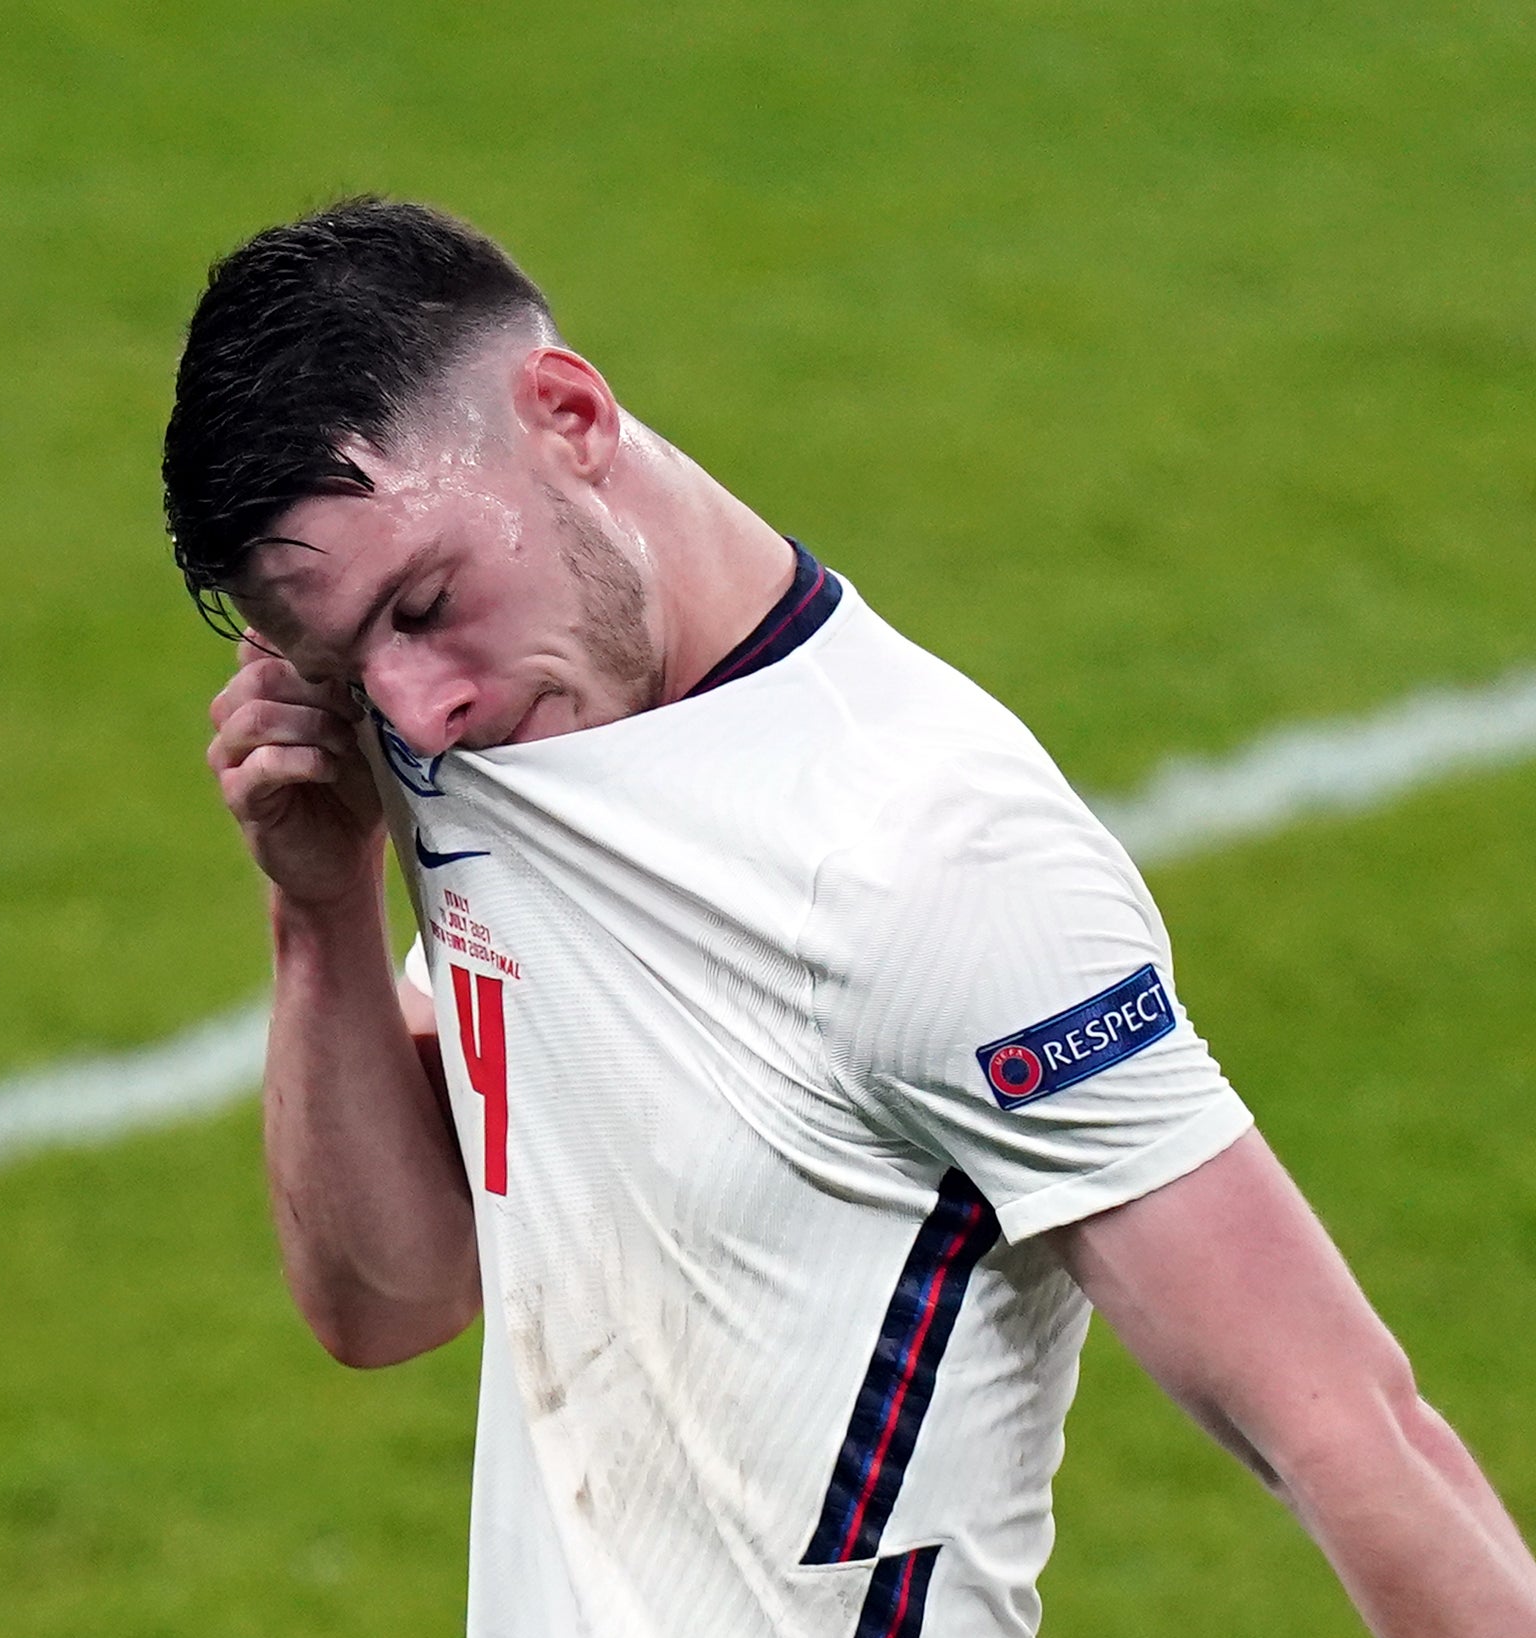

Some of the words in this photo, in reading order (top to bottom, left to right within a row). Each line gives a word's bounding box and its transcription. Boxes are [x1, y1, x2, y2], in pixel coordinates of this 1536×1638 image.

[444, 889, 469, 913] ITALY
[449, 911, 467, 932] JULY
[469, 920, 490, 944] 2021
[446, 930, 467, 953] EURO
[490, 950, 520, 980] FINAL
[1042, 983, 1167, 1071] RESPECT
[994, 1048, 1023, 1066] UEFA
[450, 963, 508, 1196] 4
